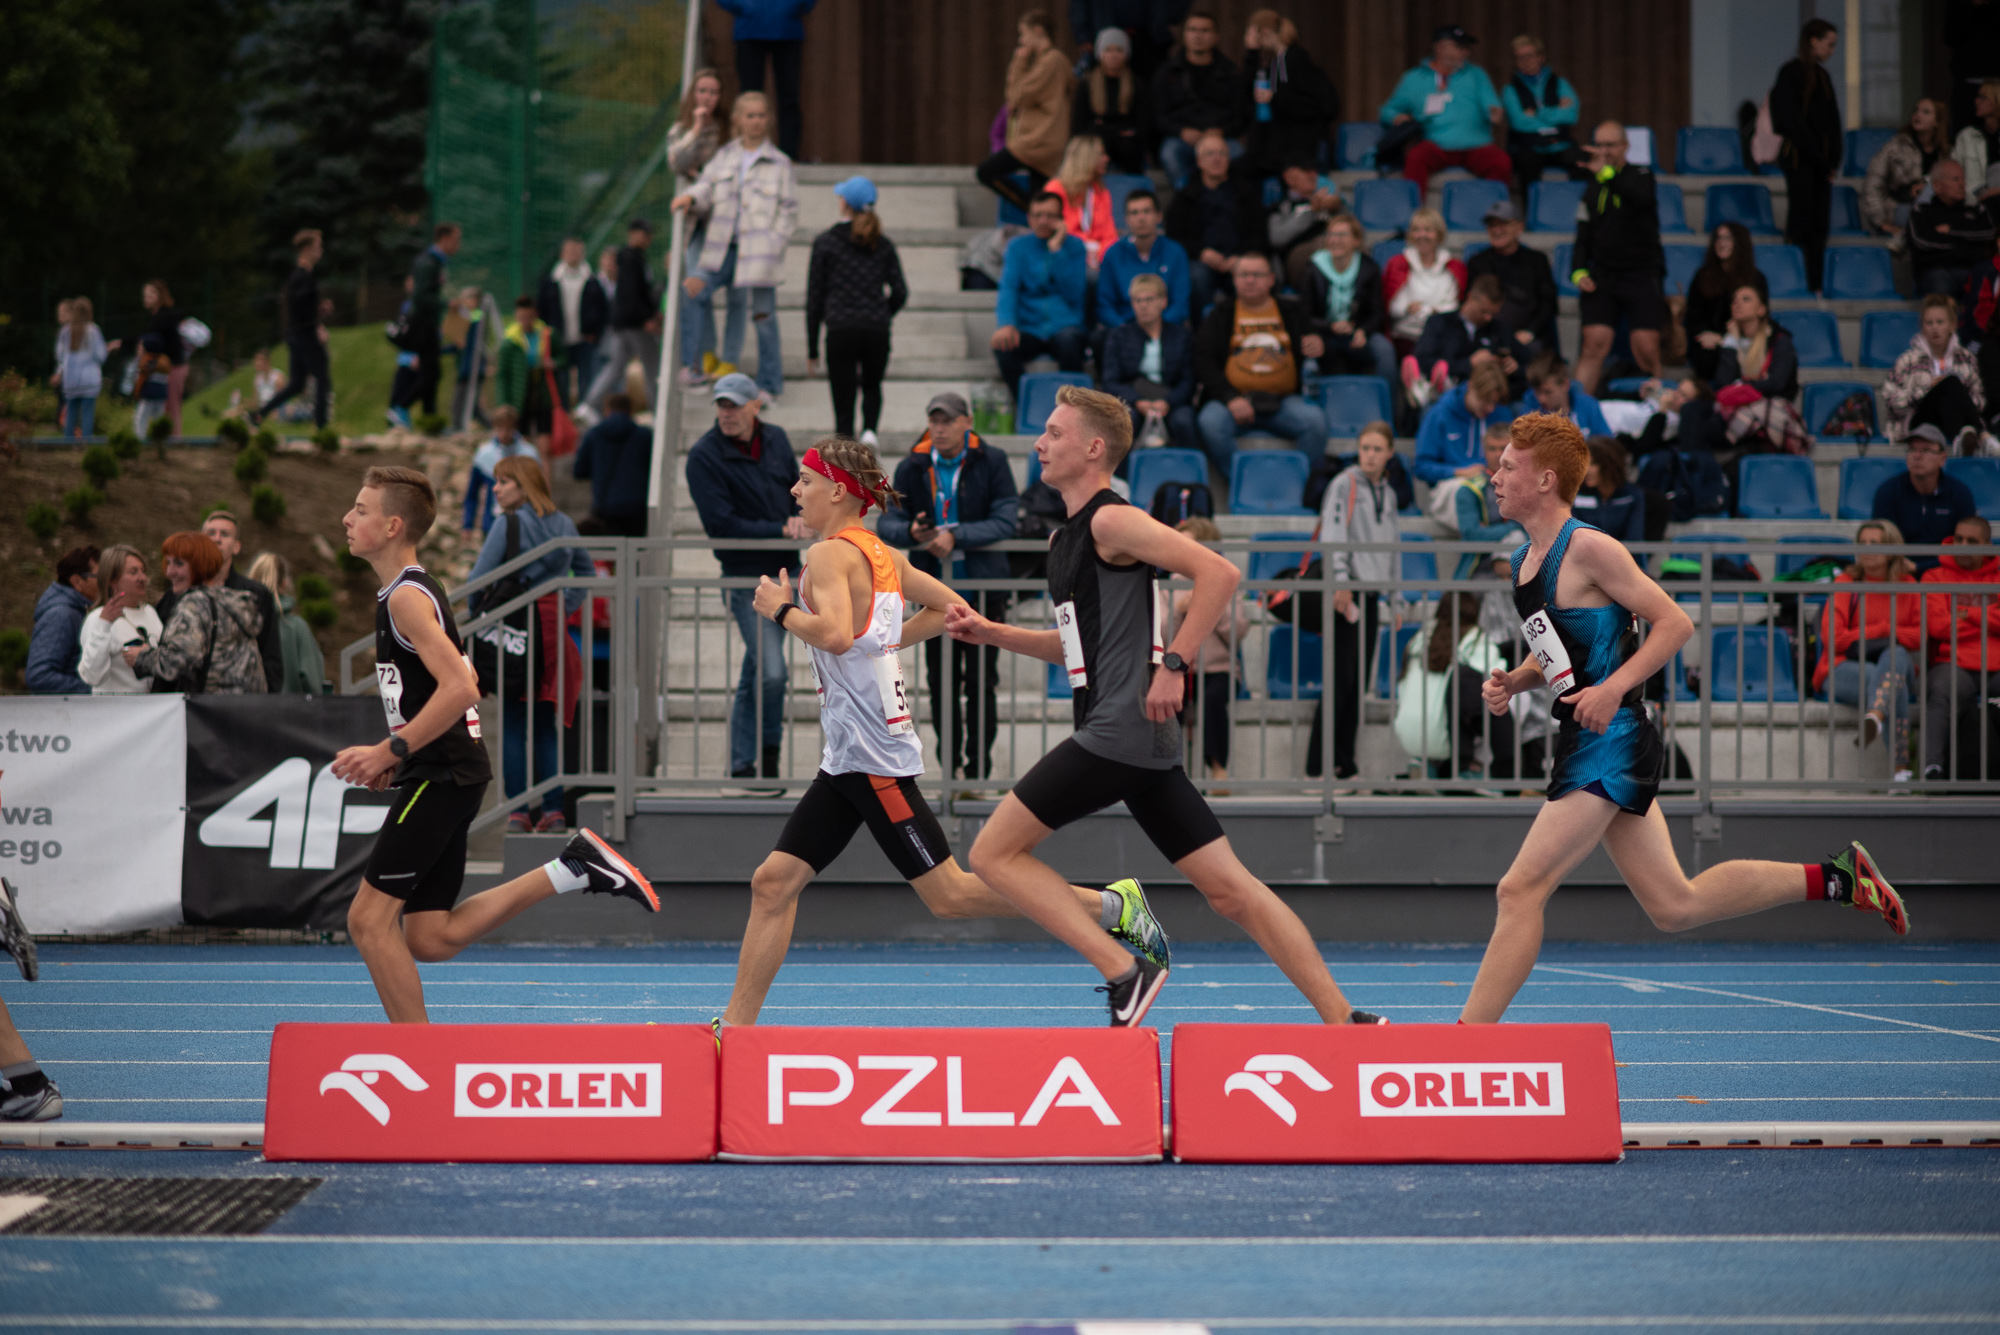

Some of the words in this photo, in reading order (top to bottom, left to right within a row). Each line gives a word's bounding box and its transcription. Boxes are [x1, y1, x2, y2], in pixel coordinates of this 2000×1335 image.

[378, 667, 398, 685] 72
[0, 729, 72, 754] two
[0, 840, 63, 865] ego
[467, 1072, 647, 1109] ORLEN
[768, 1054, 1122, 1126] PZLA
[1371, 1071, 1550, 1108] ORLEN
